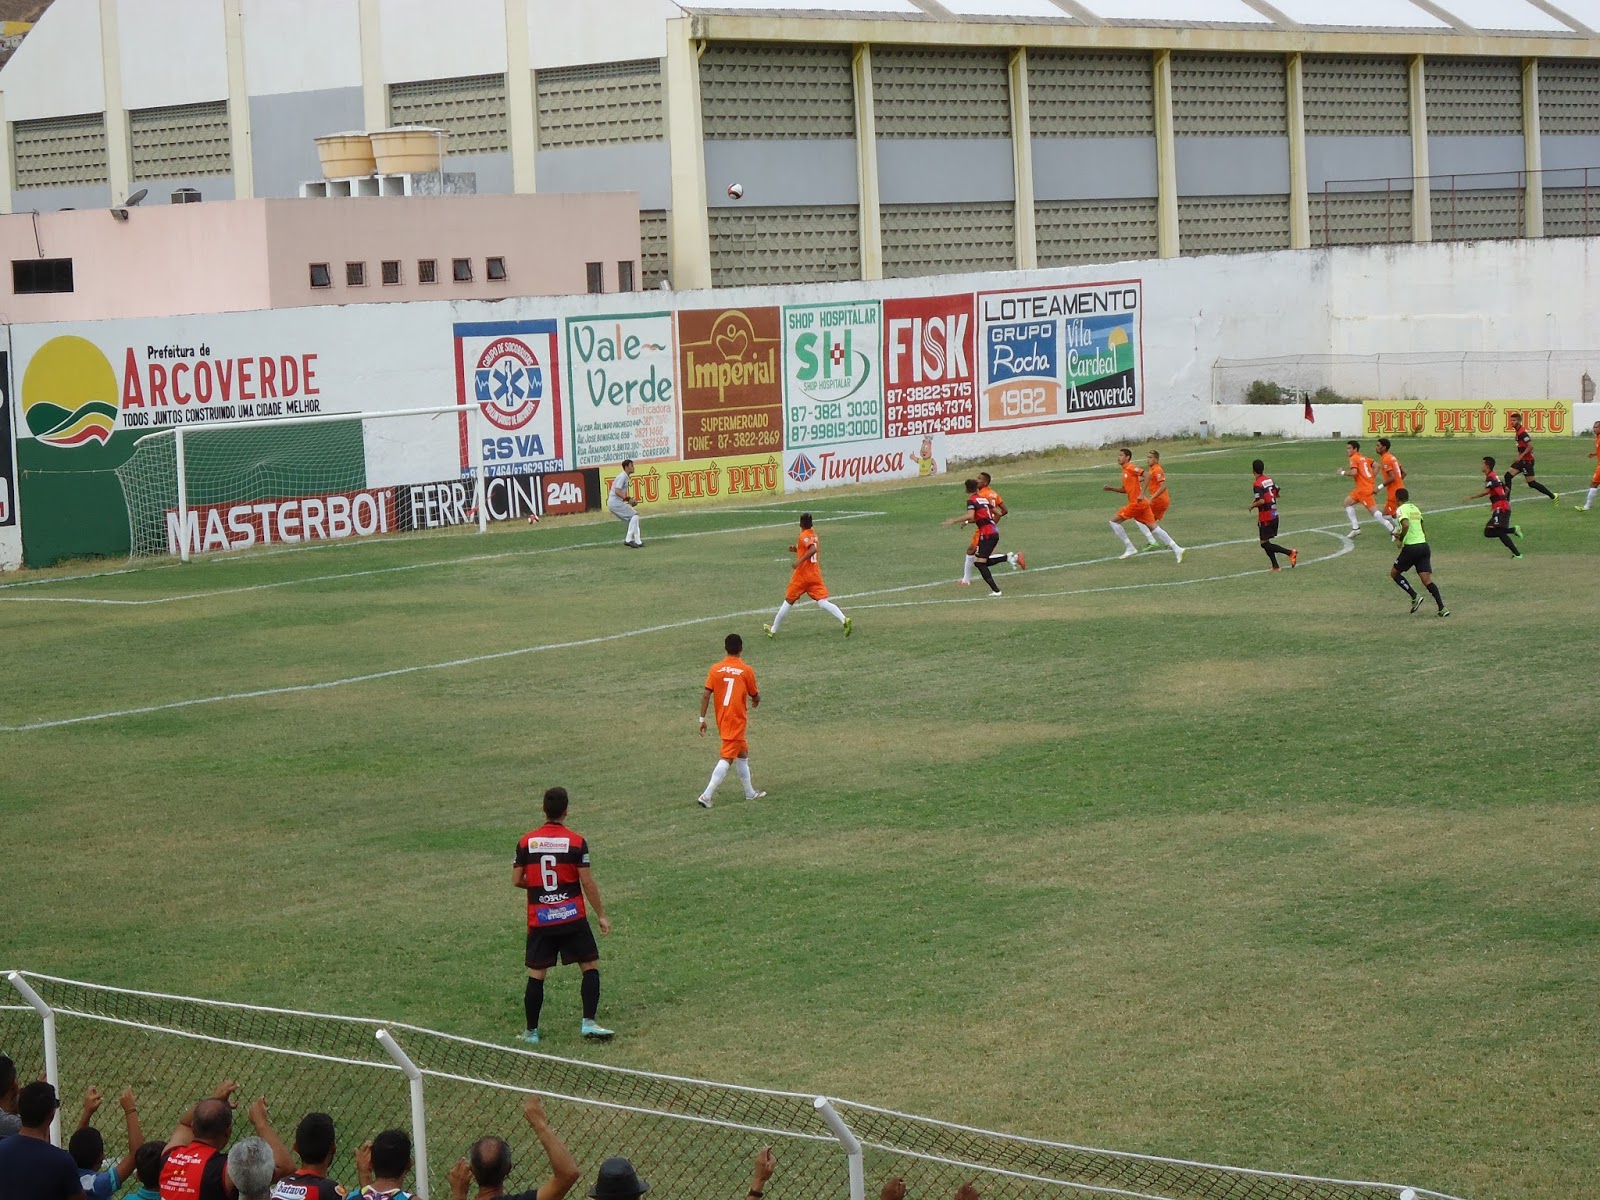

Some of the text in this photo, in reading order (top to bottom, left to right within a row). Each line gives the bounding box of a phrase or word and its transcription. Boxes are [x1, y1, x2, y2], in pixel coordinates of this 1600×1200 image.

[789, 308, 876, 329] SHOP HOSPITALAR
[985, 289, 1137, 321] LOTEAMENTO
[574, 323, 641, 363] Vale
[889, 313, 969, 383] FISK
[992, 324, 1052, 342] GRUPO
[1067, 318, 1092, 347] Vila
[147, 343, 210, 359] Prefeitura de
[483, 347, 497, 367] GRUPO
[498, 344, 504, 353] DE
[795, 329, 852, 380] SH
[993, 342, 1050, 375] Rocha
[1068, 343, 1117, 377] Cardeal
[122, 347, 320, 409] ARCOVERDE
[587, 365, 672, 407] Verde
[686, 348, 775, 402] Imperial
[803, 377, 851, 390] SHOP HOSPITALAR
[1001, 388, 1046, 415] 1982
[1069, 375, 1133, 411] Arcoverde
[123, 412, 149, 426] TODOS
[152, 410, 183, 425] JUNTOS
[185, 406, 236, 422] CONSTRUINDO
[238, 404, 253, 418] UMA
[256, 401, 282, 416] CIDADE
[627, 404, 671, 416] Panificadora
[701, 413, 769, 433] SUPERMERCADO
[791, 400, 878, 423] 87-3821 3030
[1368, 402, 1427, 433] PITÚ
[1435, 402, 1495, 433] PITÚ
[667, 461, 719, 500] PITÚ
[728, 456, 778, 494] PITÚ
[819, 449, 905, 483] Turquesa
[547, 481, 582, 506] 24h
[166, 491, 388, 556] MASTERBOI
[723, 677, 735, 706] 7
[540, 855, 558, 892] 6
